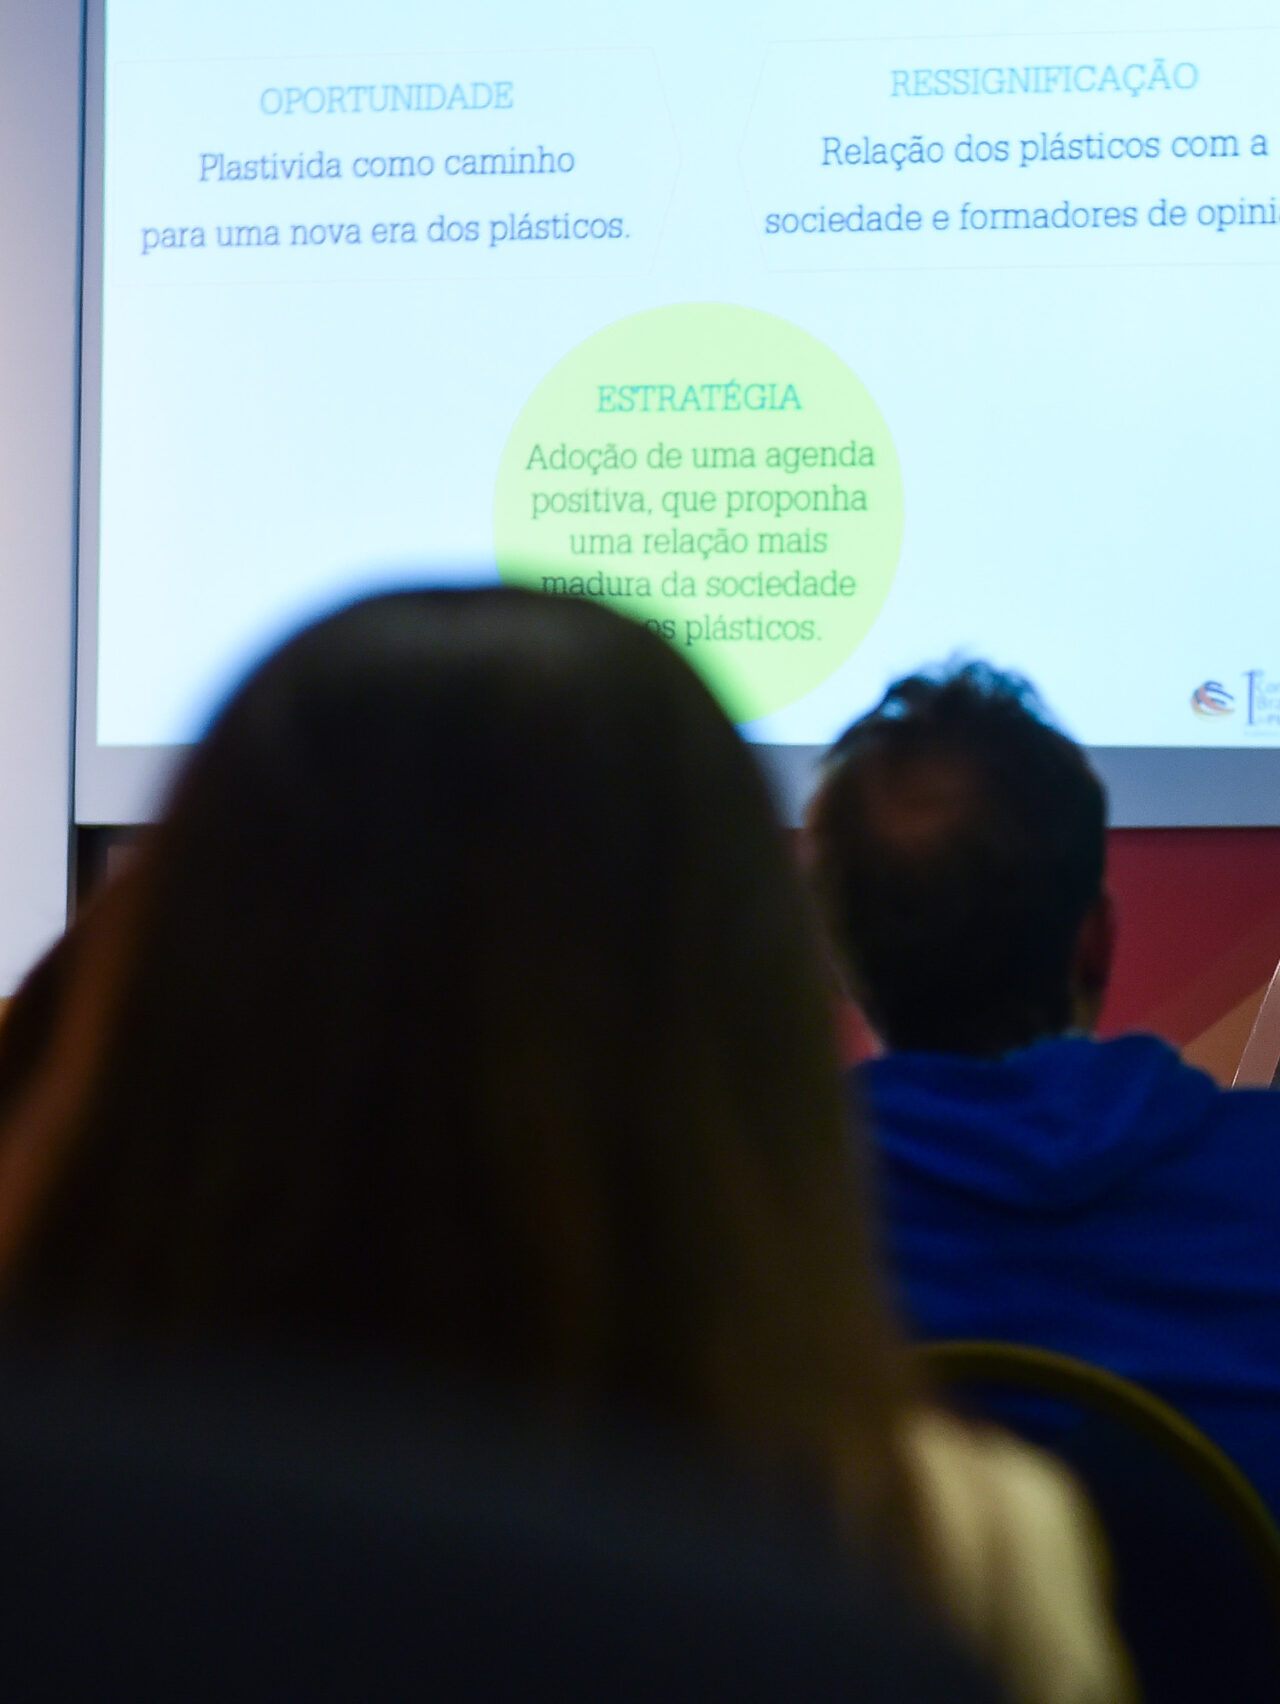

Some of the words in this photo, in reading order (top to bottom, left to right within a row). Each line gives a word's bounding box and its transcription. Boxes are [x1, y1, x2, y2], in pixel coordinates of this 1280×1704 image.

[890, 57, 1200, 98] RESSIGNIFICAÇÃO
[260, 81, 514, 115] OPORTUNIDADE
[199, 150, 343, 182] Plastivida
[352, 155, 435, 178] como
[445, 145, 575, 176] caminho
[821, 135, 945, 172] Relação
[954, 133, 1010, 163] dos
[1019, 132, 1161, 168] plásticos
[1171, 135, 1240, 158] com
[1250, 134, 1269, 157] a
[141, 226, 207, 256] para
[216, 225, 281, 247] uma
[290, 223, 362, 246] nova
[371, 222, 418, 244] era
[427, 214, 480, 243] dos
[489, 212, 630, 248] plásticos.
[765, 203, 923, 234] sociedade
[932, 210, 950, 231] e
[960, 200, 1138, 230] formadores
[1147, 198, 1188, 227] de
[597, 378, 803, 413] ESTRATÉGIA
[525, 442, 638, 476] Adoção
[646, 442, 683, 470] de
[692, 447, 757, 469] uma
[765, 440, 876, 474] agenda
[532, 488, 653, 520] positiva,
[661, 491, 717, 519] que
[726, 483, 869, 519] proponha
[570, 533, 634, 556] uma
[643, 527, 750, 561] relação
[758, 528, 829, 554] mais
[542, 570, 651, 597] madura
[661, 571, 696, 597] da
[706, 569, 856, 597] sociedade
[684, 615, 823, 646] plásticos.
